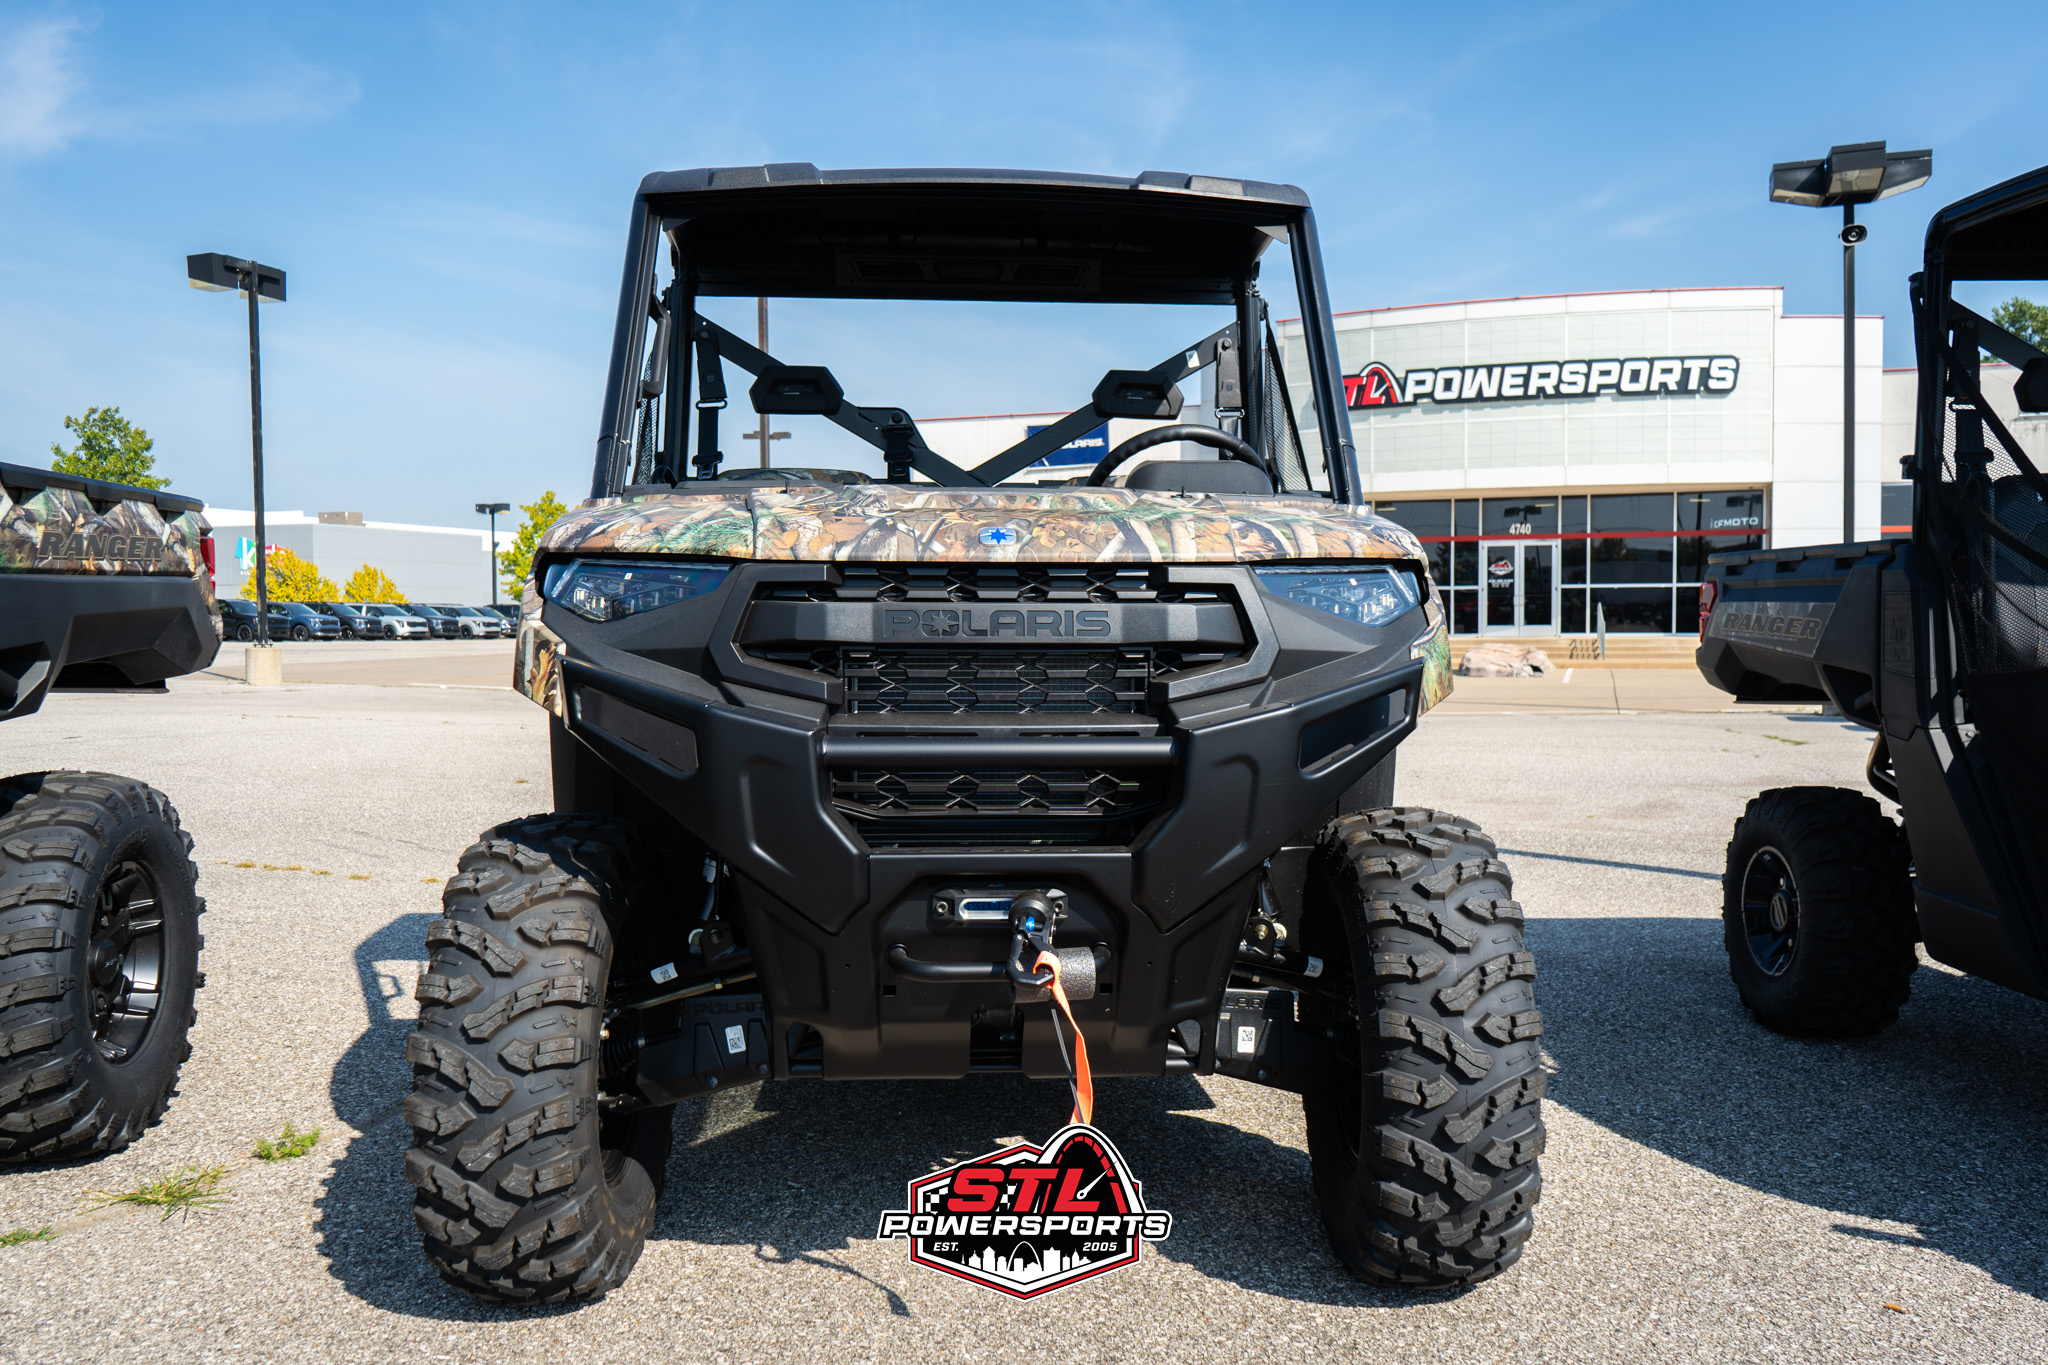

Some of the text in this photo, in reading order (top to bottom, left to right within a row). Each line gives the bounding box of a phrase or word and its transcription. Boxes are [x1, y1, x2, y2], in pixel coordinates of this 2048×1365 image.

[1342, 357, 1736, 406] TL POWERSPORTS
[1061, 438, 1103, 449] LARIS
[1509, 523, 1532, 535] 4740
[1713, 517, 1759, 528] CFMOTO
[37, 530, 163, 560] RANGER
[884, 610, 1111, 637] POLARIS
[1722, 612, 1822, 639] RANGER
